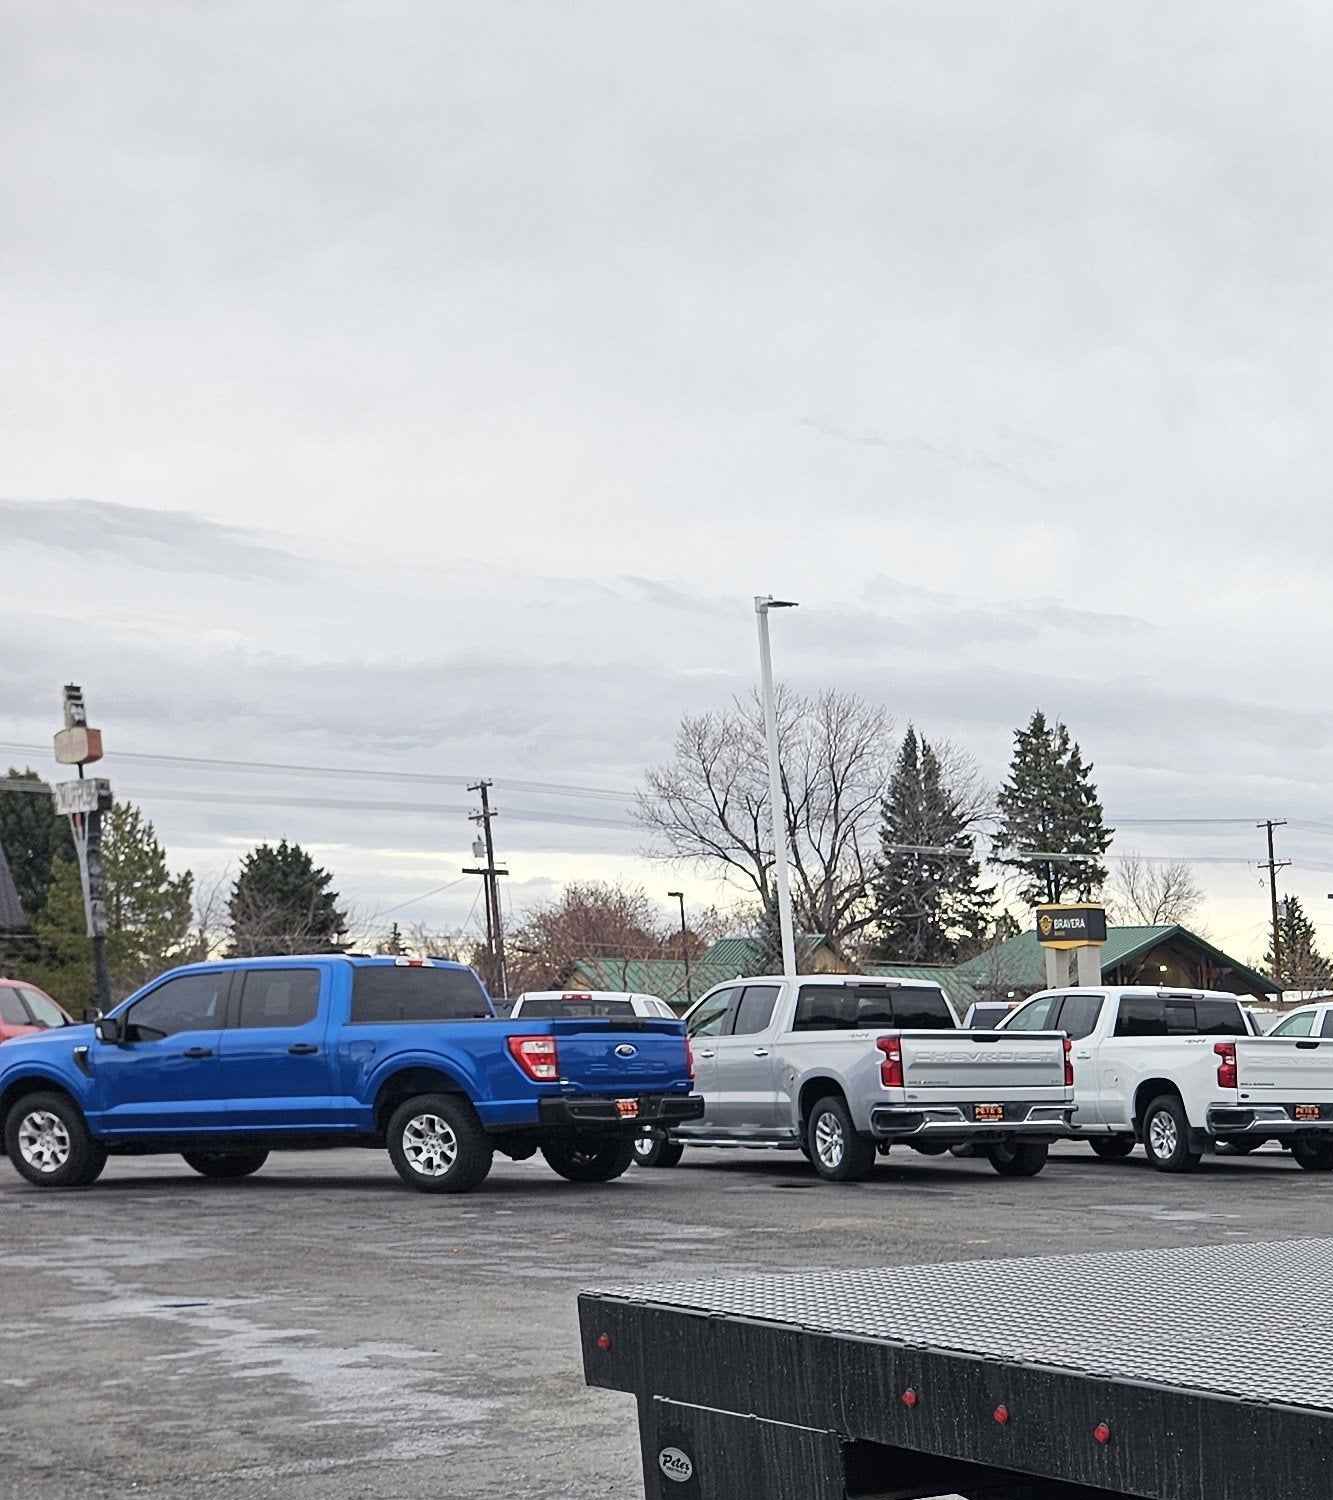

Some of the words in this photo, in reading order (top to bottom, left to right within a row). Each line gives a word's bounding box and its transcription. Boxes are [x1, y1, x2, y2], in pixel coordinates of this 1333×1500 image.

[1053, 918, 1086, 930] BRAVERA
[914, 1051, 1056, 1063] CHEVROLET
[975, 1106, 1004, 1114] PETE'S
[1295, 1106, 1319, 1114] PETE'S
